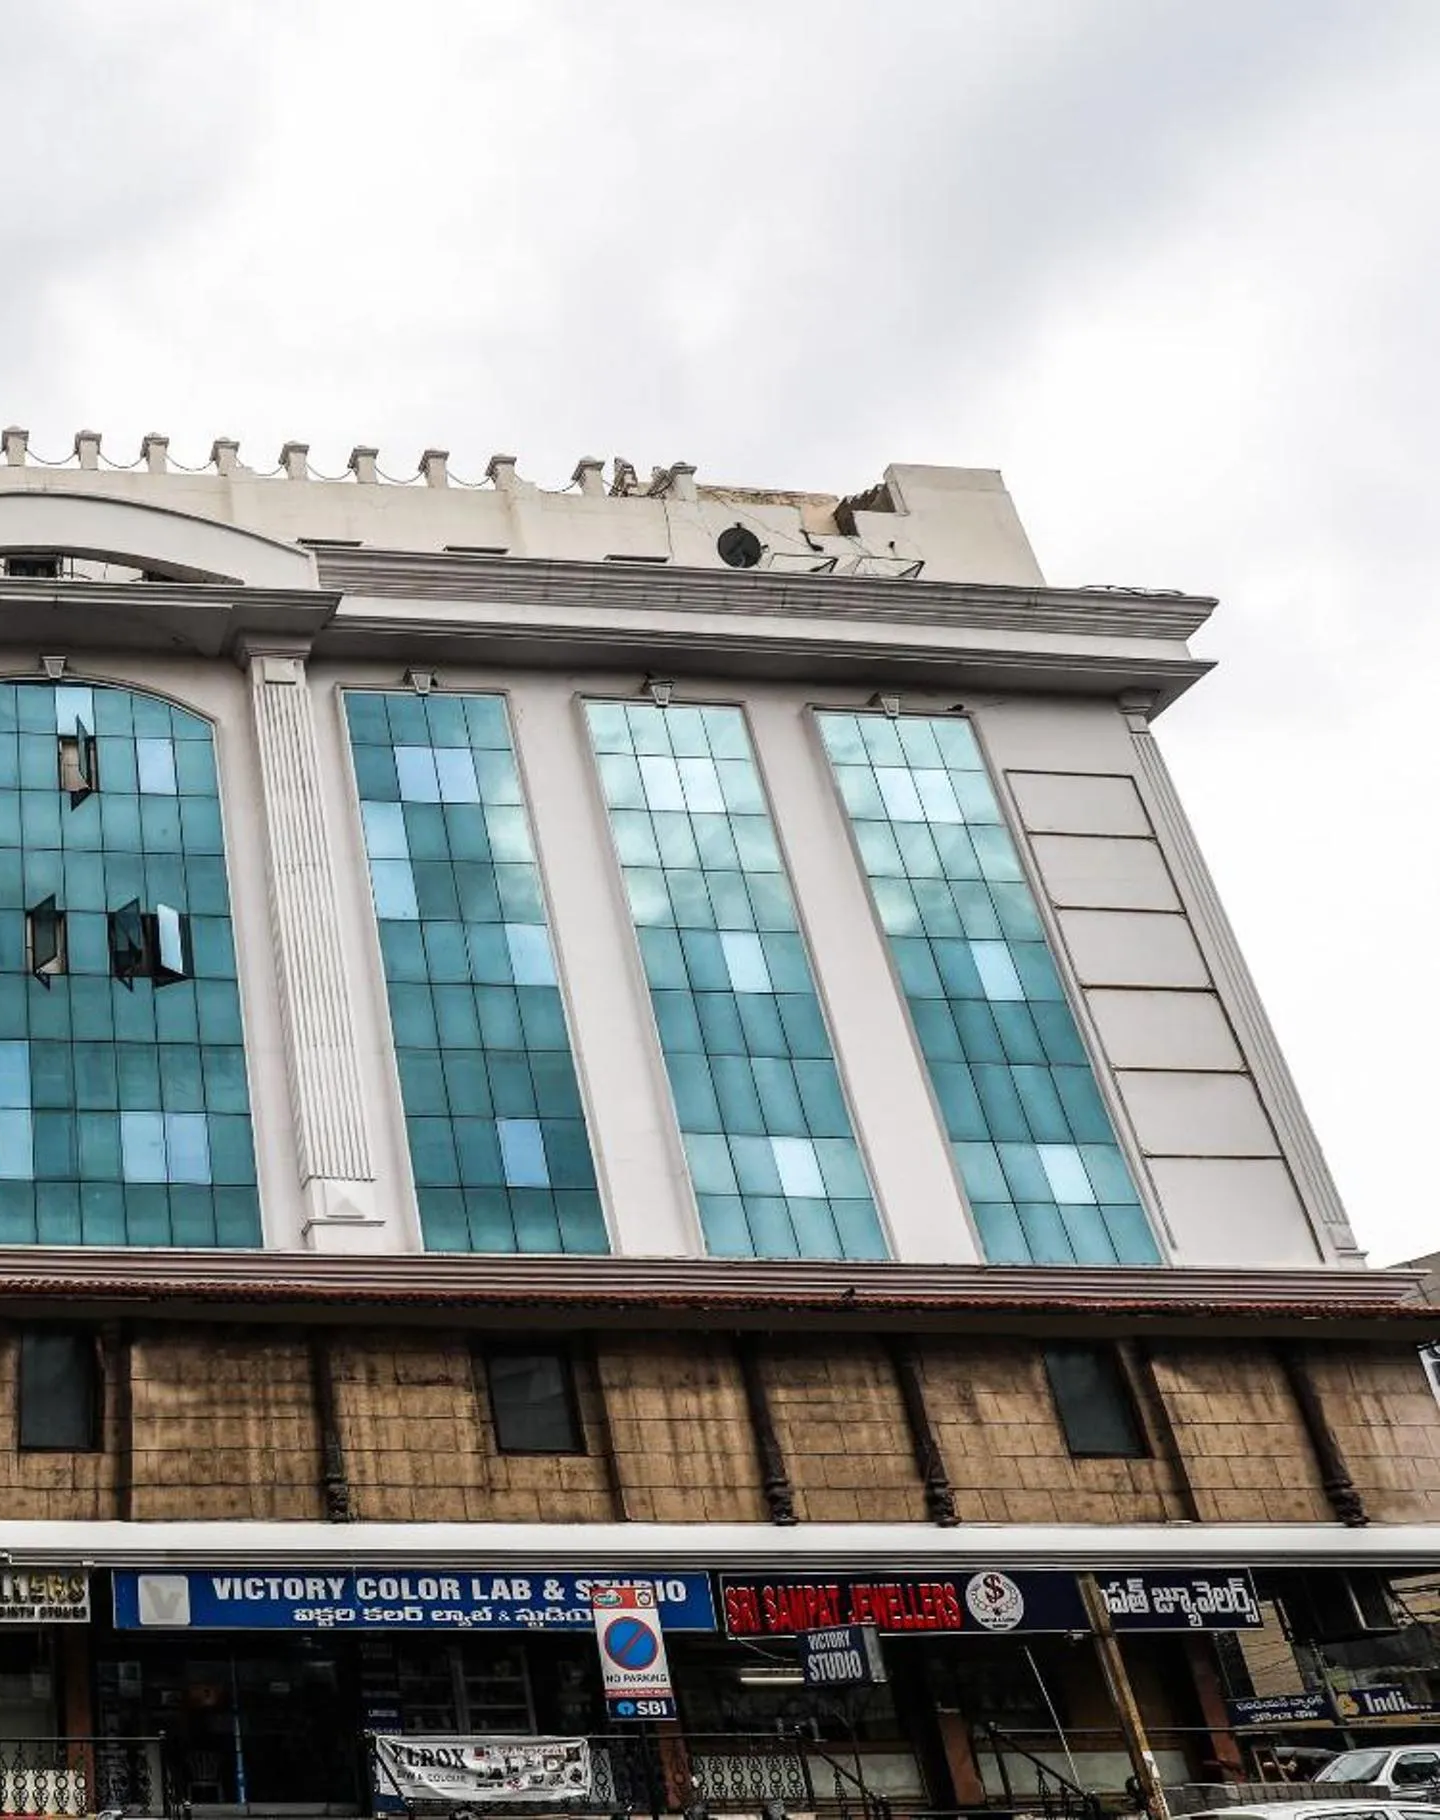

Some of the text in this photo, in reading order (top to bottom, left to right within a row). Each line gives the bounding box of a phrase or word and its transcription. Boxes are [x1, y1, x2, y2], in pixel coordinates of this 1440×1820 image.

[212, 1577, 346, 1601] VICTORY
[356, 1577, 461, 1601] COLOR
[471, 1578, 533, 1602] LAB
[543, 1578, 565, 1602] &
[725, 1585, 762, 1634] SRI
[762, 1585, 842, 1633] SAMPAT
[847, 1582, 965, 1630] JEWELLERS
[807, 1629, 851, 1651] VICTORY
[807, 1650, 863, 1682] STUDIO
[623, 1673, 667, 1683] PARKING
[636, 1701, 668, 1716] SBI
